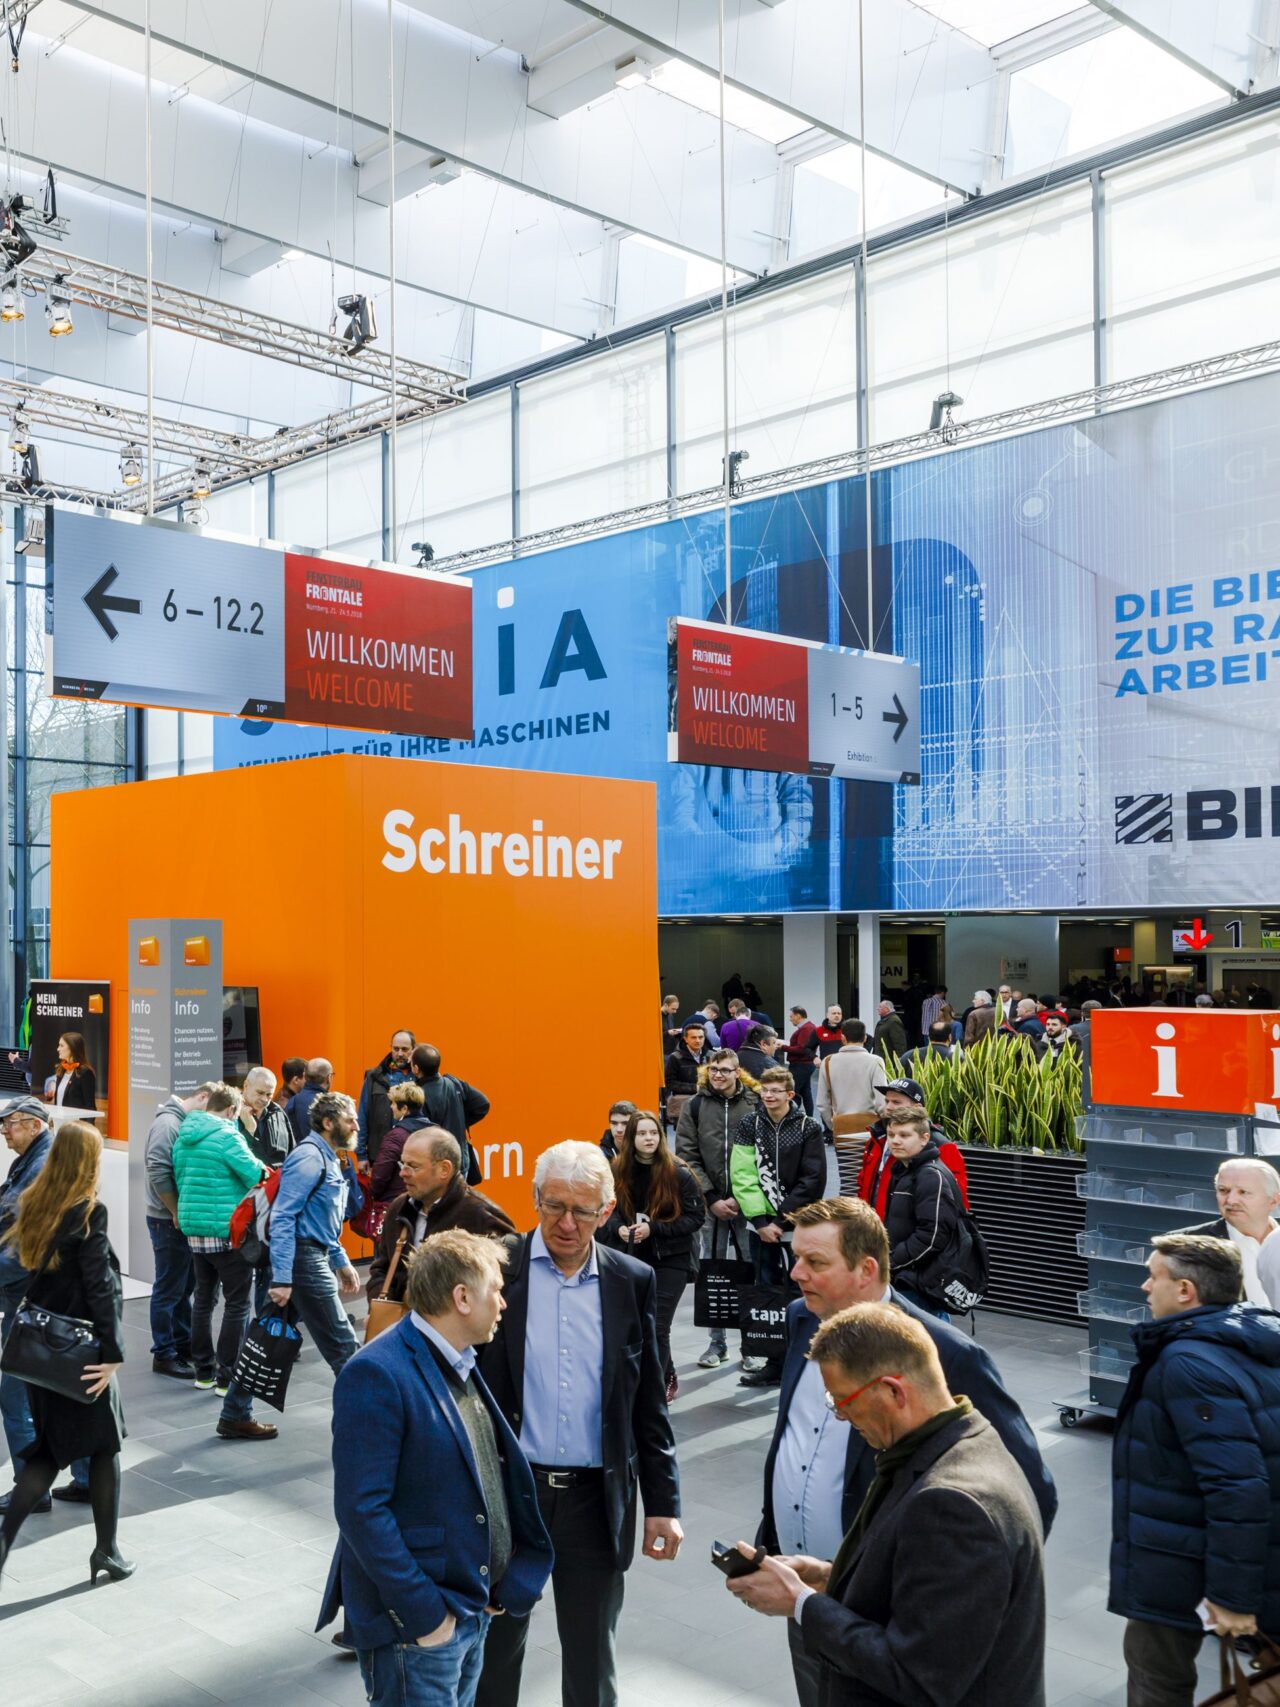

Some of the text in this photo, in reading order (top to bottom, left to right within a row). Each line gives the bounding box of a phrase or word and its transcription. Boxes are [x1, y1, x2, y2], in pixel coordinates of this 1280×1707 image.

[306, 583, 363, 607] FRONTALE
[1115, 583, 1194, 623] DIE
[163, 588, 178, 623] 6
[212, 595, 265, 636] 12.2
[306, 628, 454, 678] WILLKOMMEN
[1115, 620, 1214, 661] ZUR
[692, 649, 732, 666] FRONTALE
[306, 670, 415, 712] WELCOME
[692, 685, 796, 723] WILLKOMMEN
[831, 692, 836, 717] 1
[855, 696, 863, 720] 5
[693, 719, 768, 752] WELCOME
[381, 809, 623, 881] Schreiner
[1224, 919, 1243, 949] 1
[36, 993, 57, 1005] MEIN
[36, 1004, 84, 1018] SCHREINER
[131, 999, 151, 1015] Info
[175, 1000, 200, 1015] Info
[750, 1307, 786, 1325] tapi
